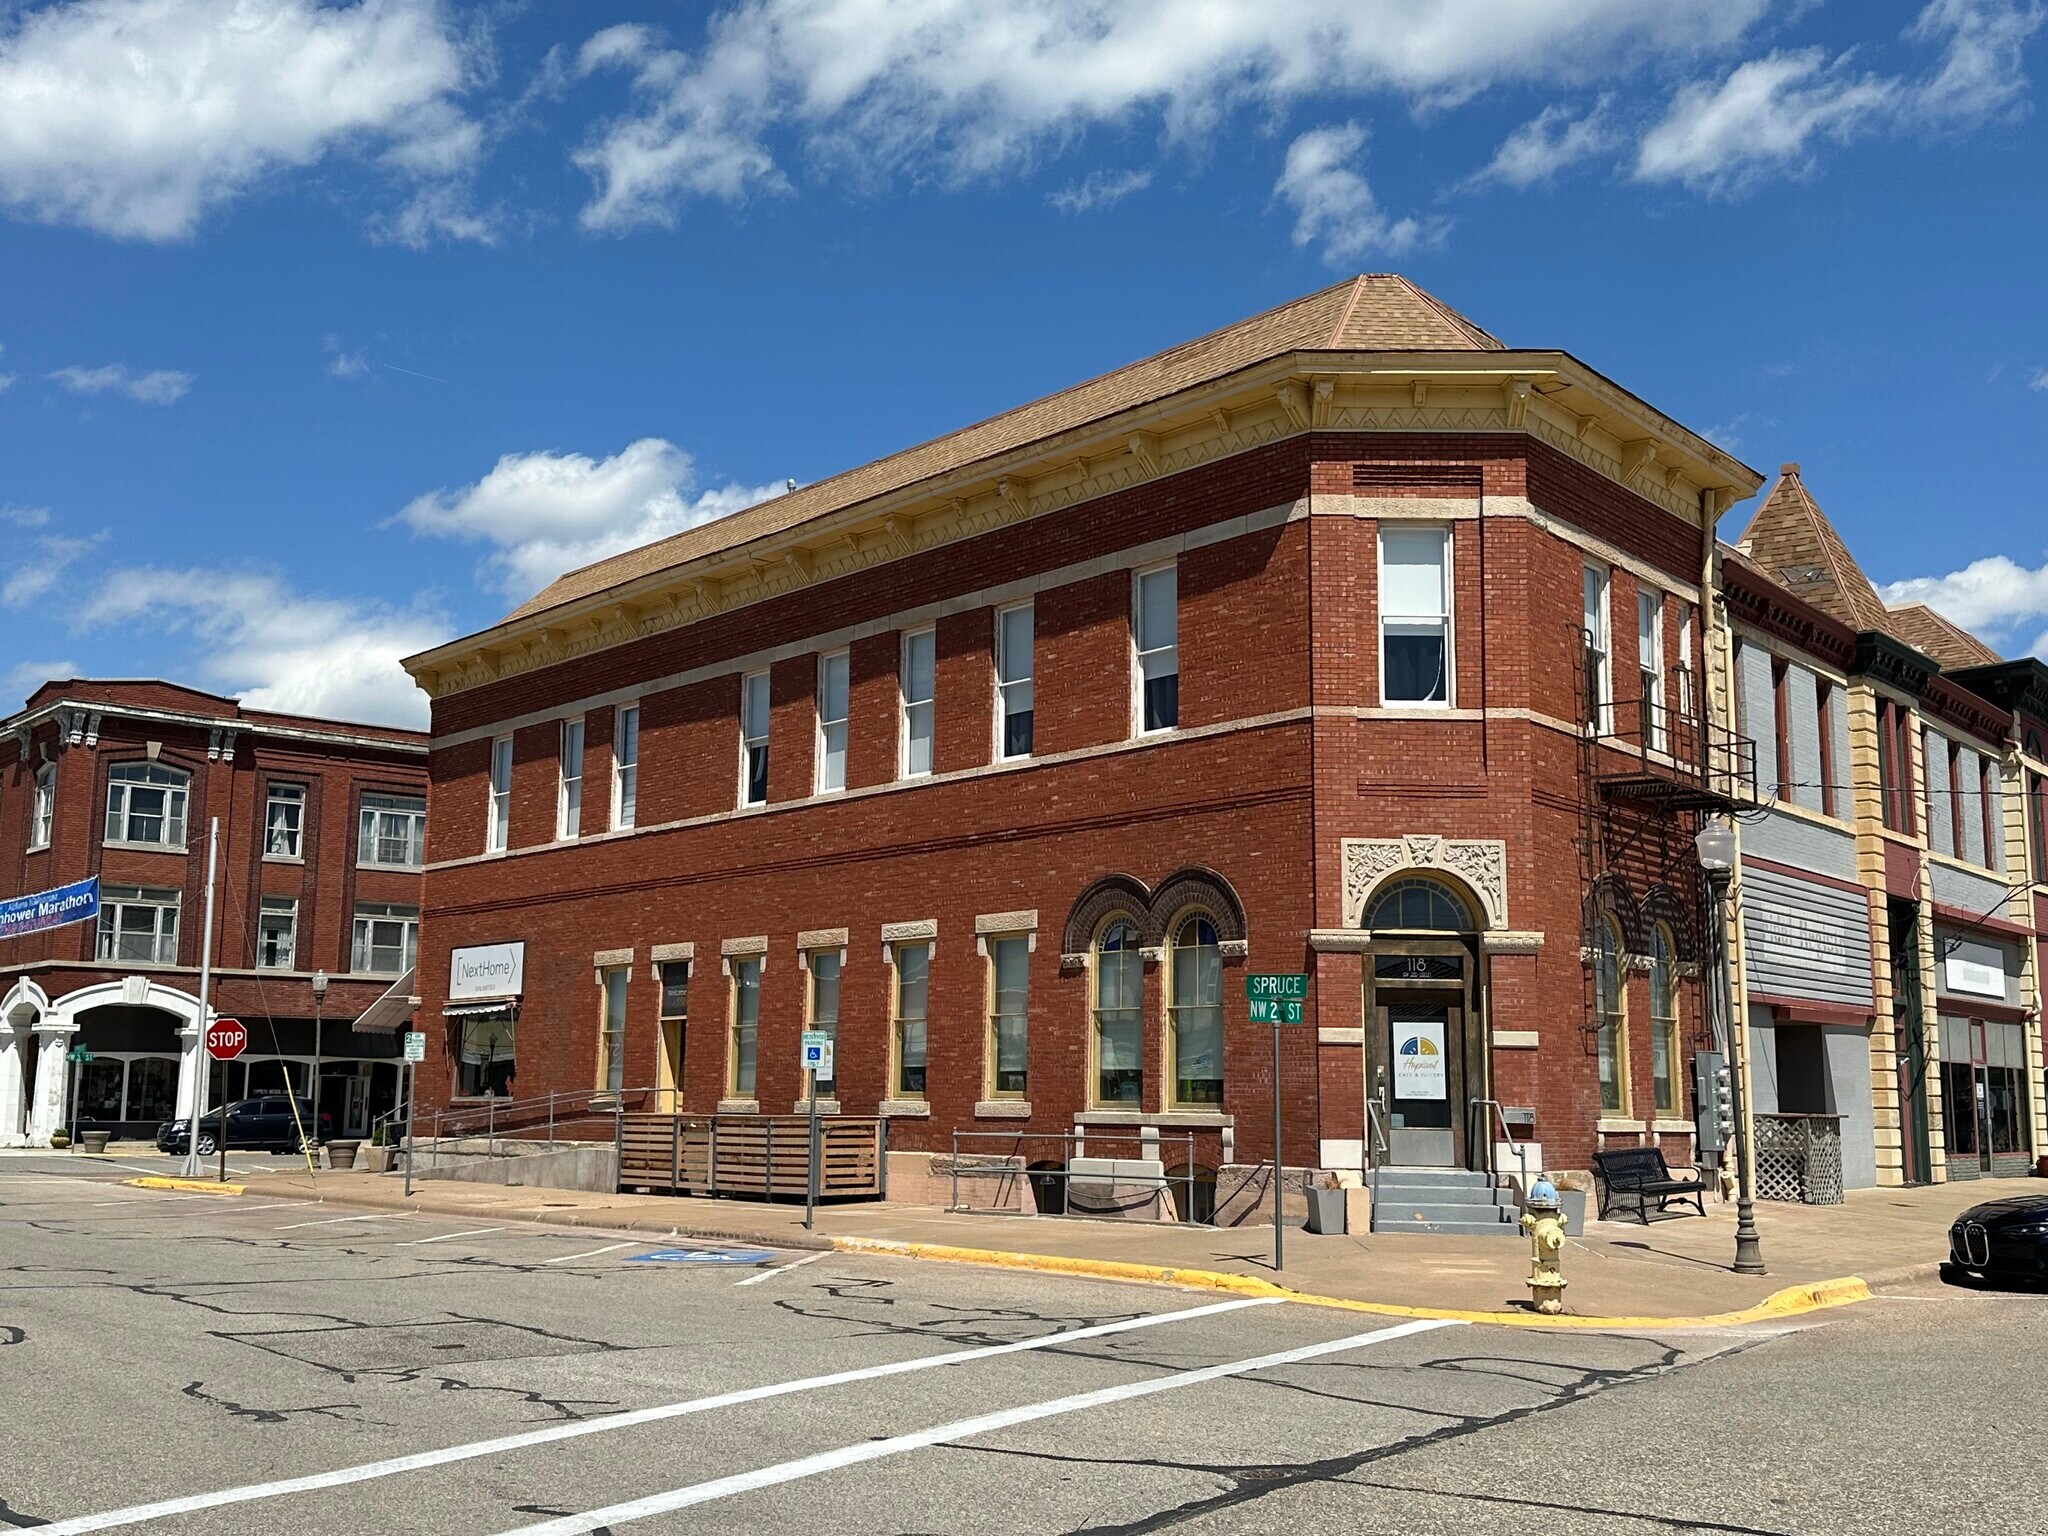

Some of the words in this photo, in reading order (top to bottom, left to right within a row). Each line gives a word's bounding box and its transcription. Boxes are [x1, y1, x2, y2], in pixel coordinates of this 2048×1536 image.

[38, 892, 94, 917] Marathon
[462, 961, 510, 979] NextHome
[1407, 957, 1427, 972] 118
[474, 984, 496, 992] UNLIMITED
[1253, 976, 1301, 994] SPRUCE
[1250, 1000, 1267, 1018] NW
[1287, 1002, 1302, 1020] ST
[208, 1031, 244, 1047] STOP
